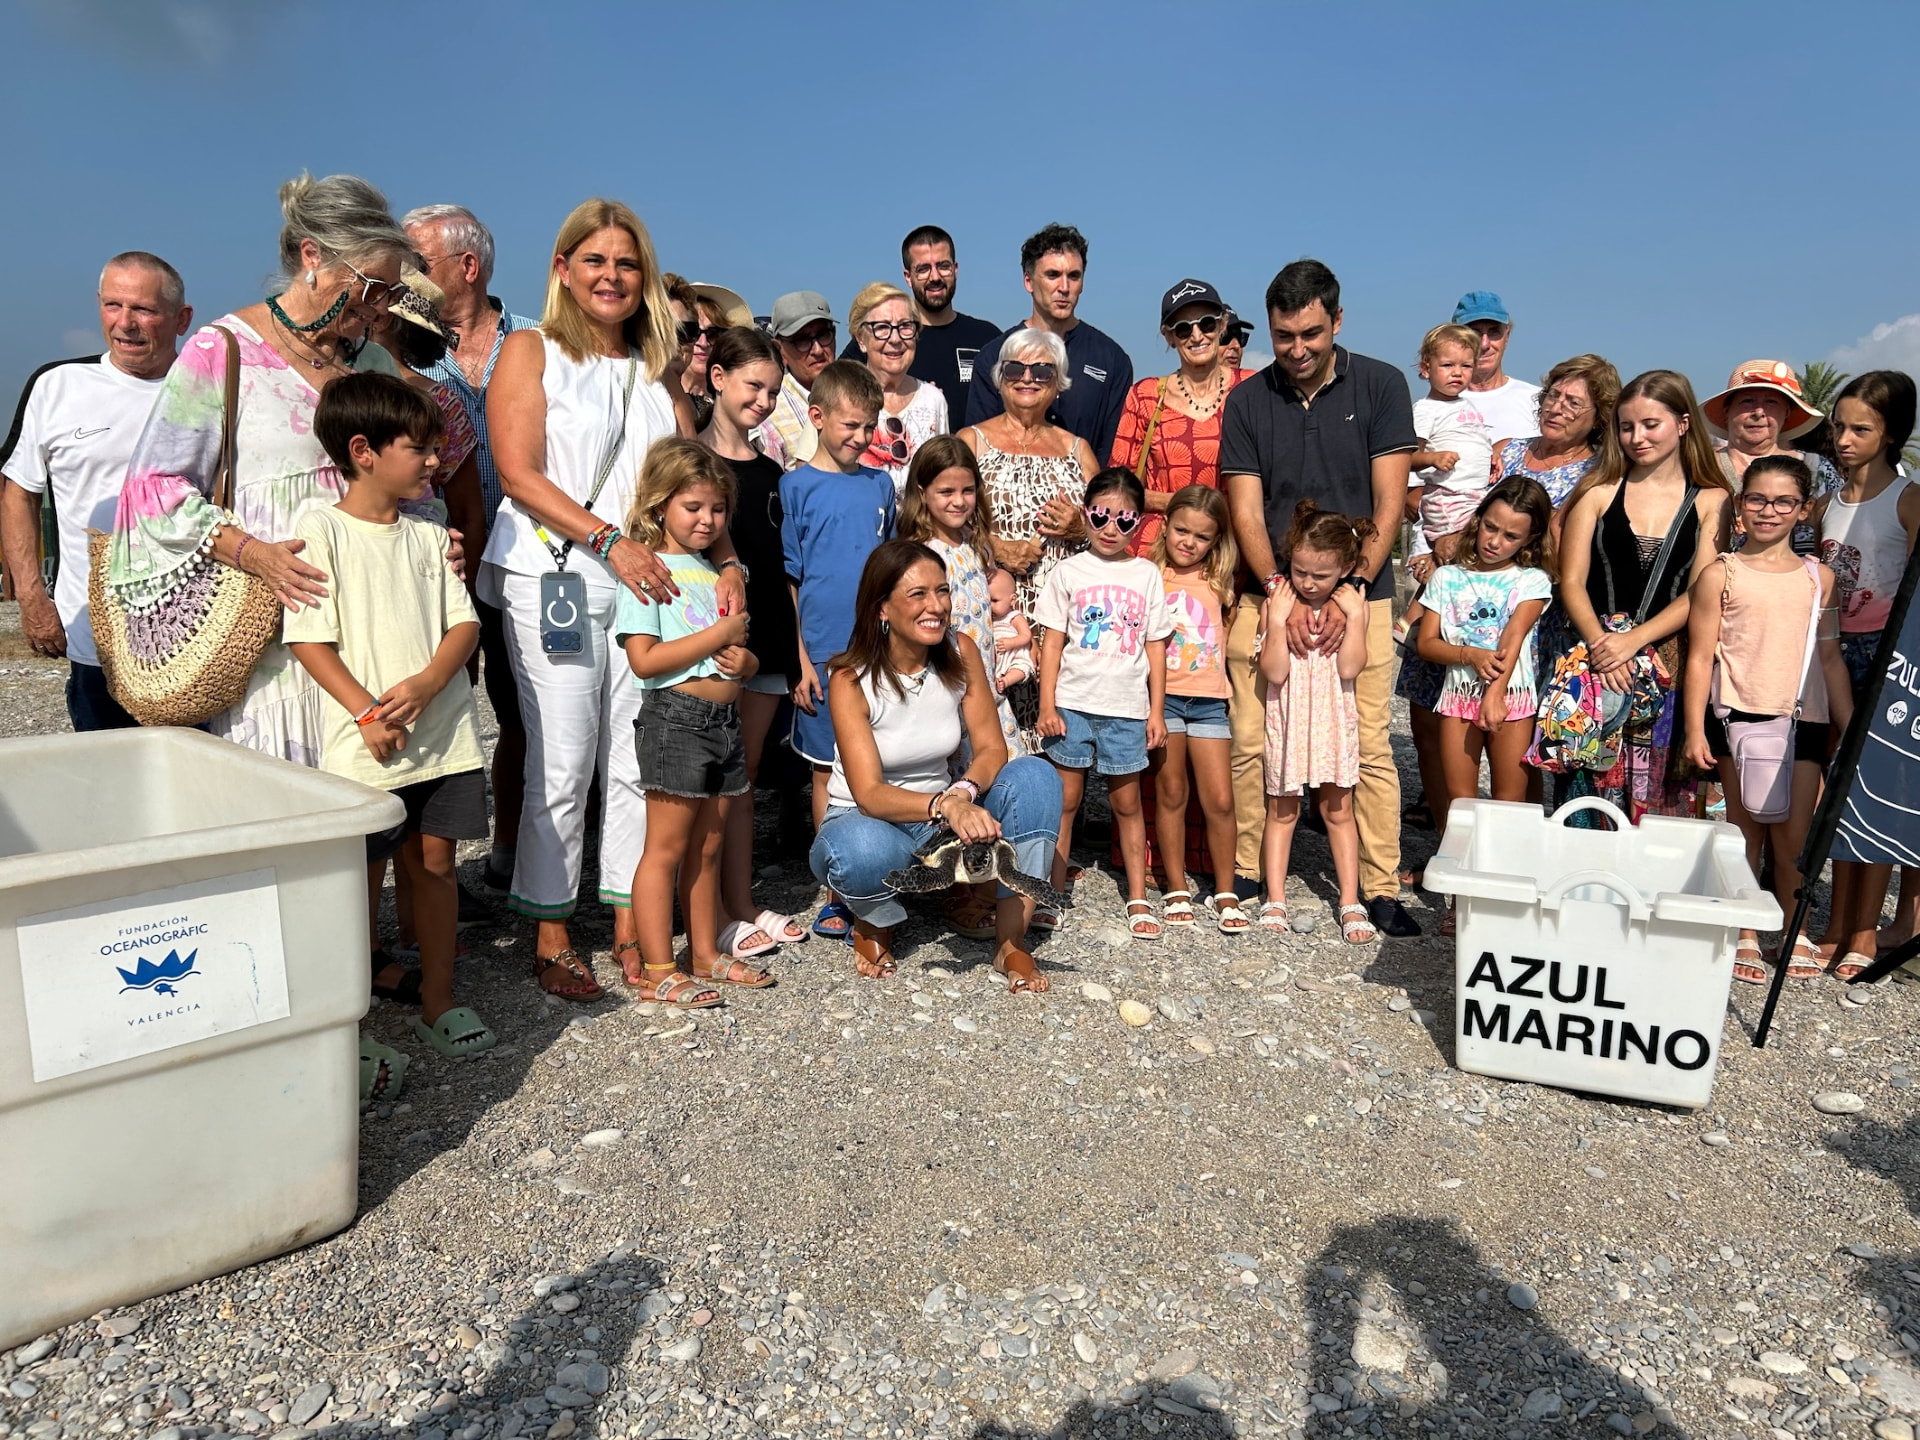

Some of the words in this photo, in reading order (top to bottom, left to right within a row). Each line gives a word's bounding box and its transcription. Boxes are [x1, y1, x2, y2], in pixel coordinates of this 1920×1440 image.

[1885, 650, 1920, 698] ZUL
[100, 923, 208, 956] OCEANOGRÀFIC
[118, 915, 189, 936] FUNDACIÓN
[1465, 951, 1626, 1010] AZUL
[127, 1003, 201, 1027] VALENCIA
[1463, 998, 1711, 1071] MARINO
